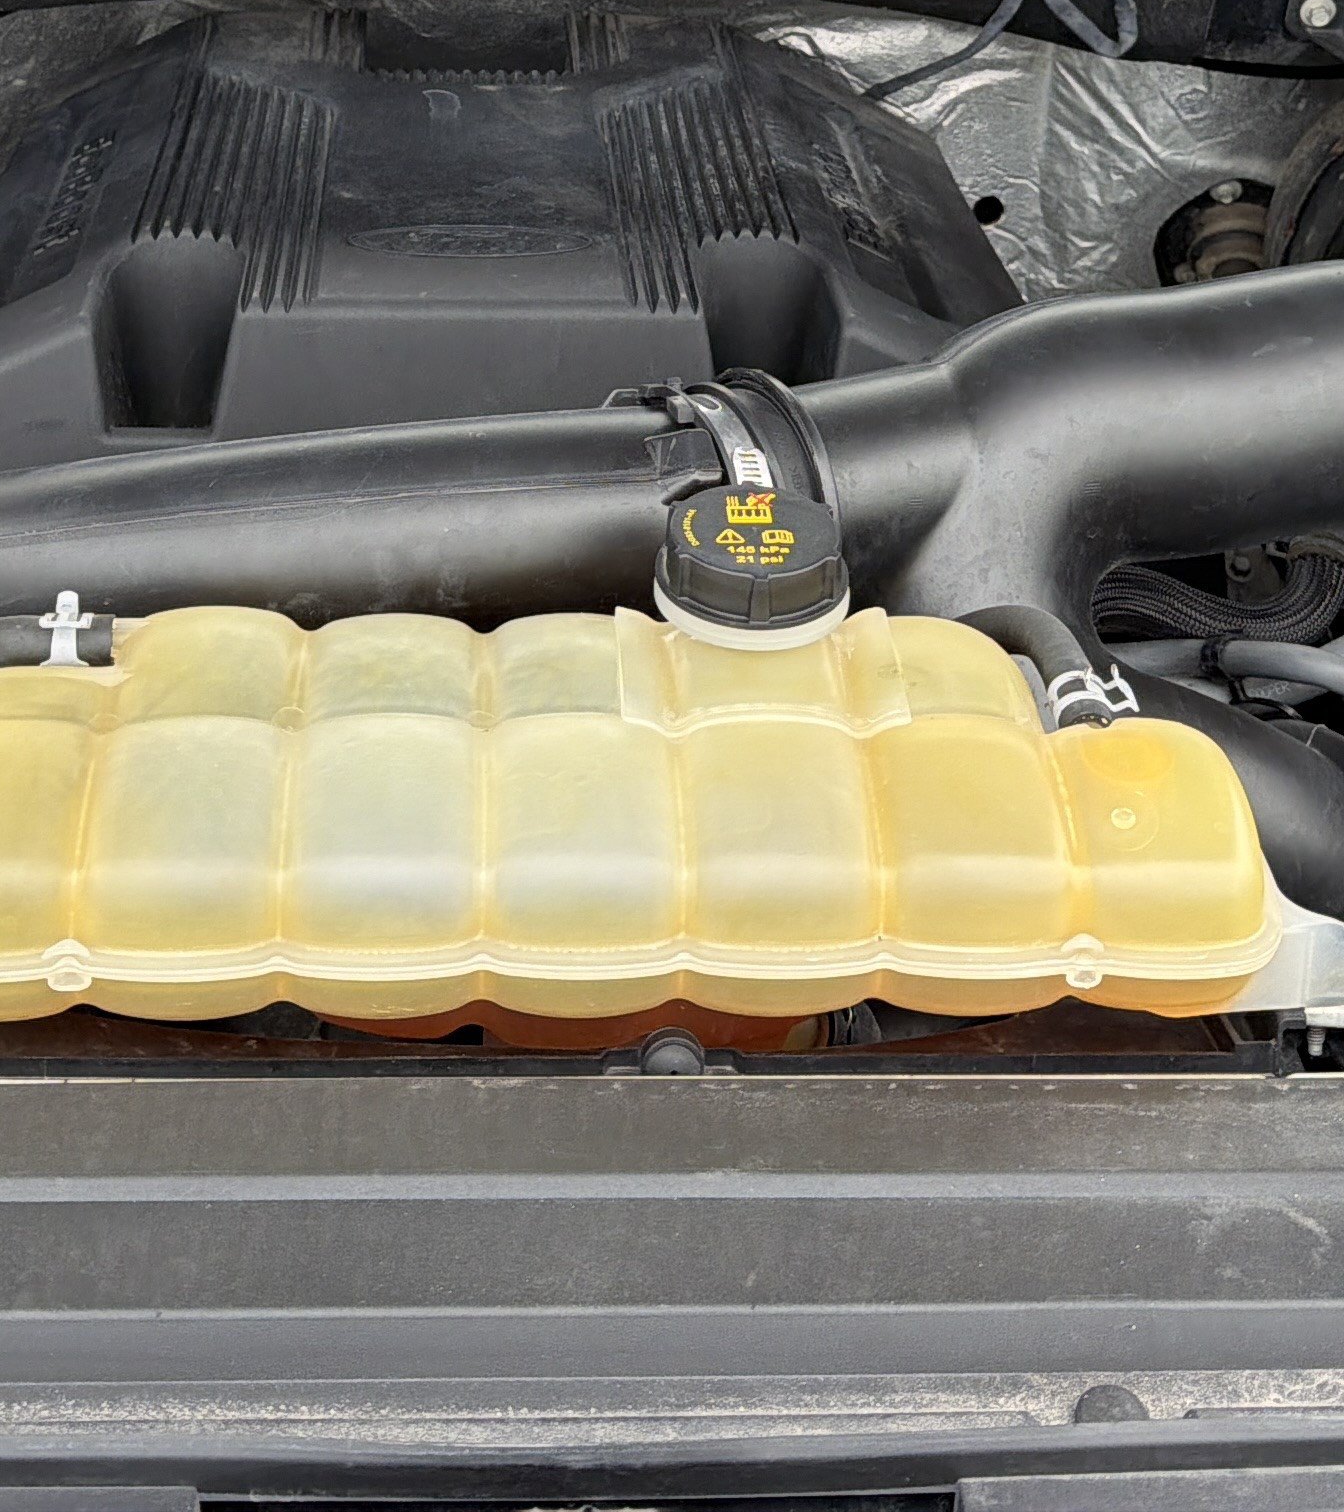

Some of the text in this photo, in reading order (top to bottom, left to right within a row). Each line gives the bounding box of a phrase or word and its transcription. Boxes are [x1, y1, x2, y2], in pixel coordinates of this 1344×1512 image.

[760, 545, 790, 554] kPa
[735, 554, 784, 565] 21 psi
